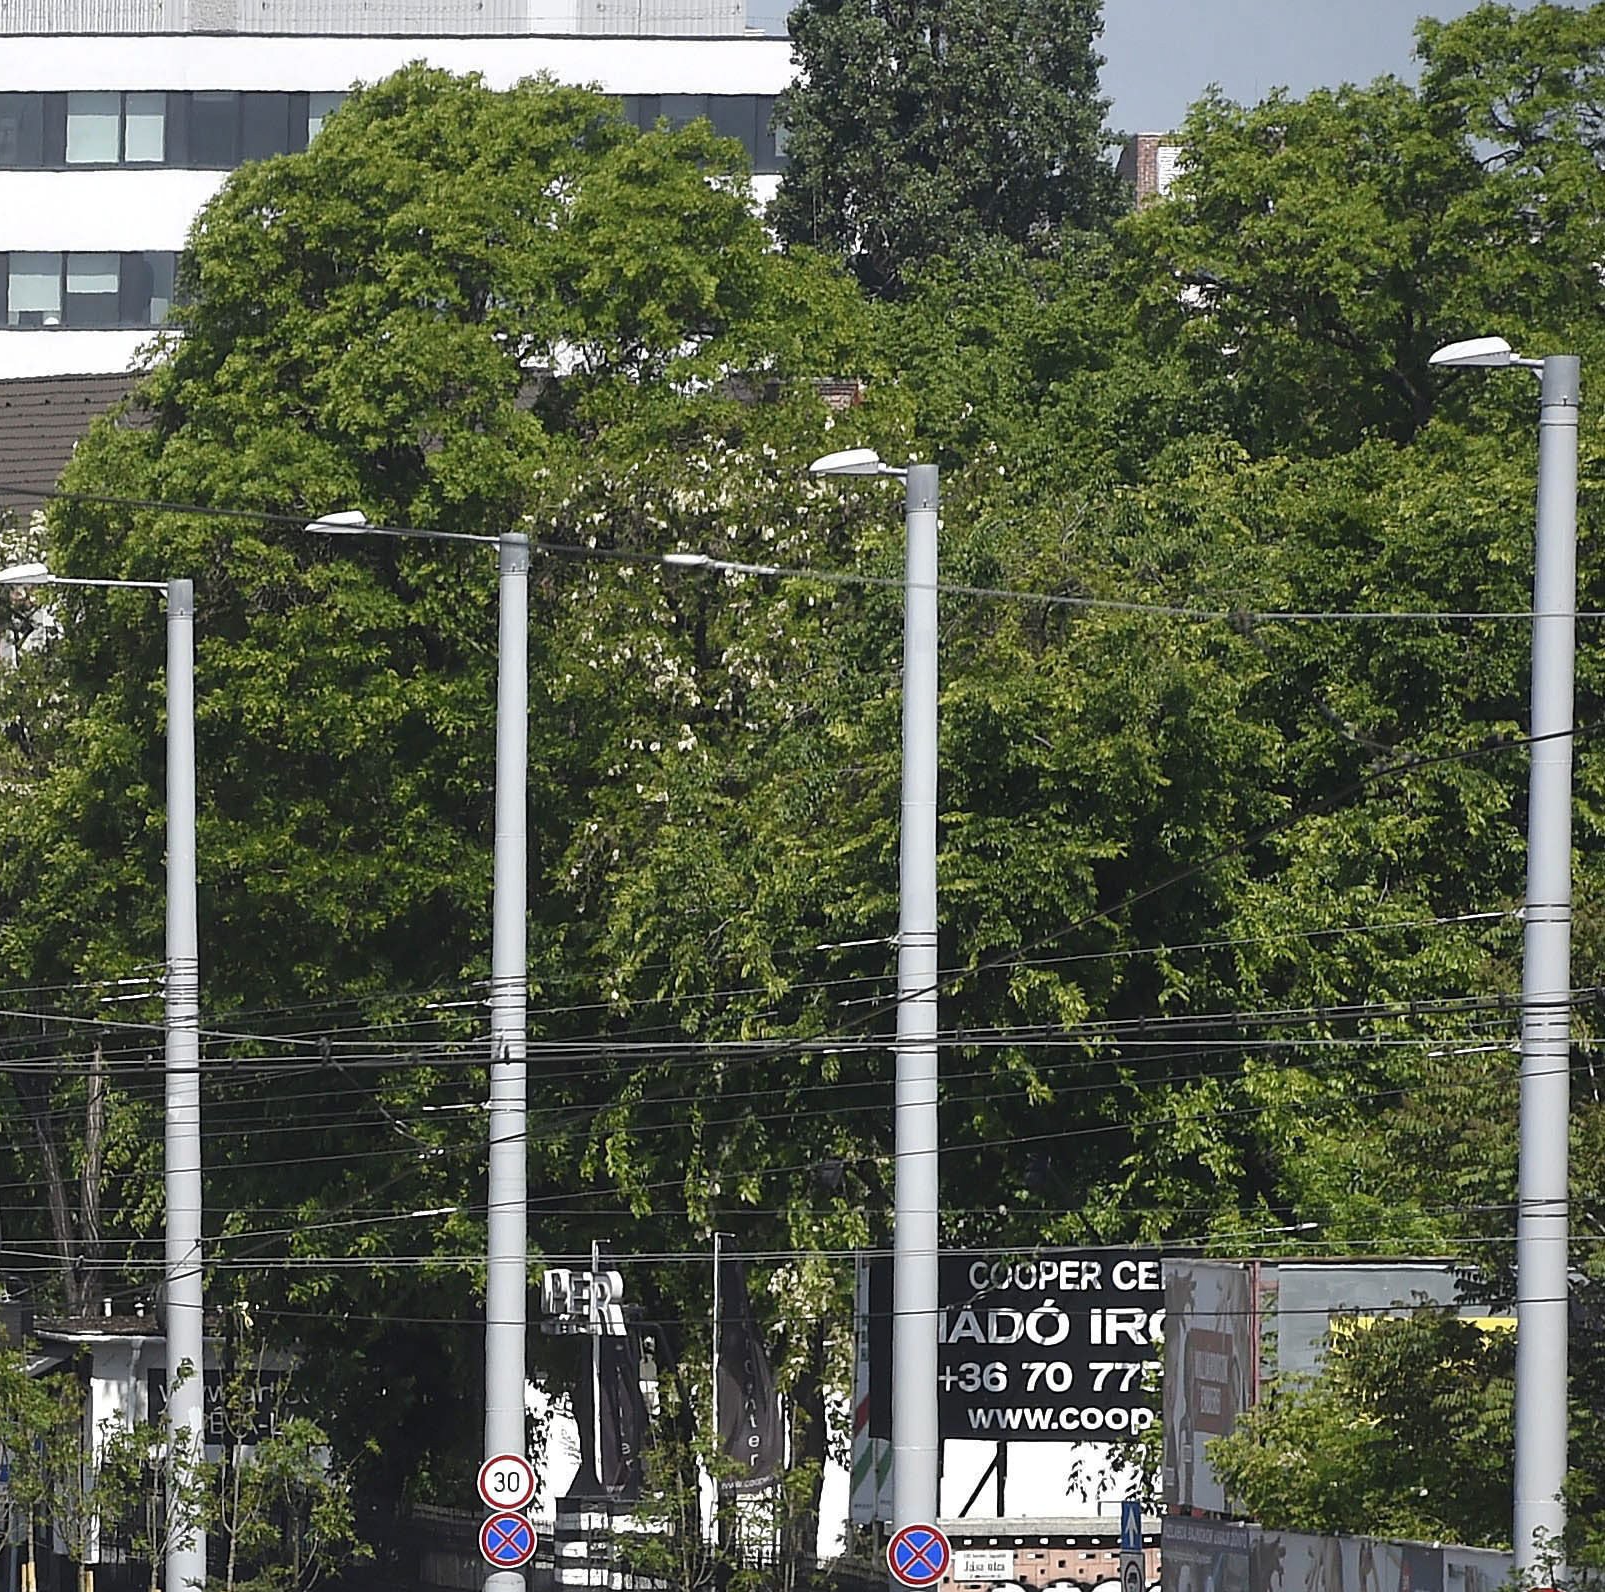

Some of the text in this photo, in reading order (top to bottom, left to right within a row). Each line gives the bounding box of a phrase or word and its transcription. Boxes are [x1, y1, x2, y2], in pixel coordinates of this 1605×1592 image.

[968, 1261, 1166, 1291] COOPER CE
[939, 1361, 1008, 1393] +36
[1022, 1361, 1074, 1393] 70
[493, 1471, 520, 1493] 30
